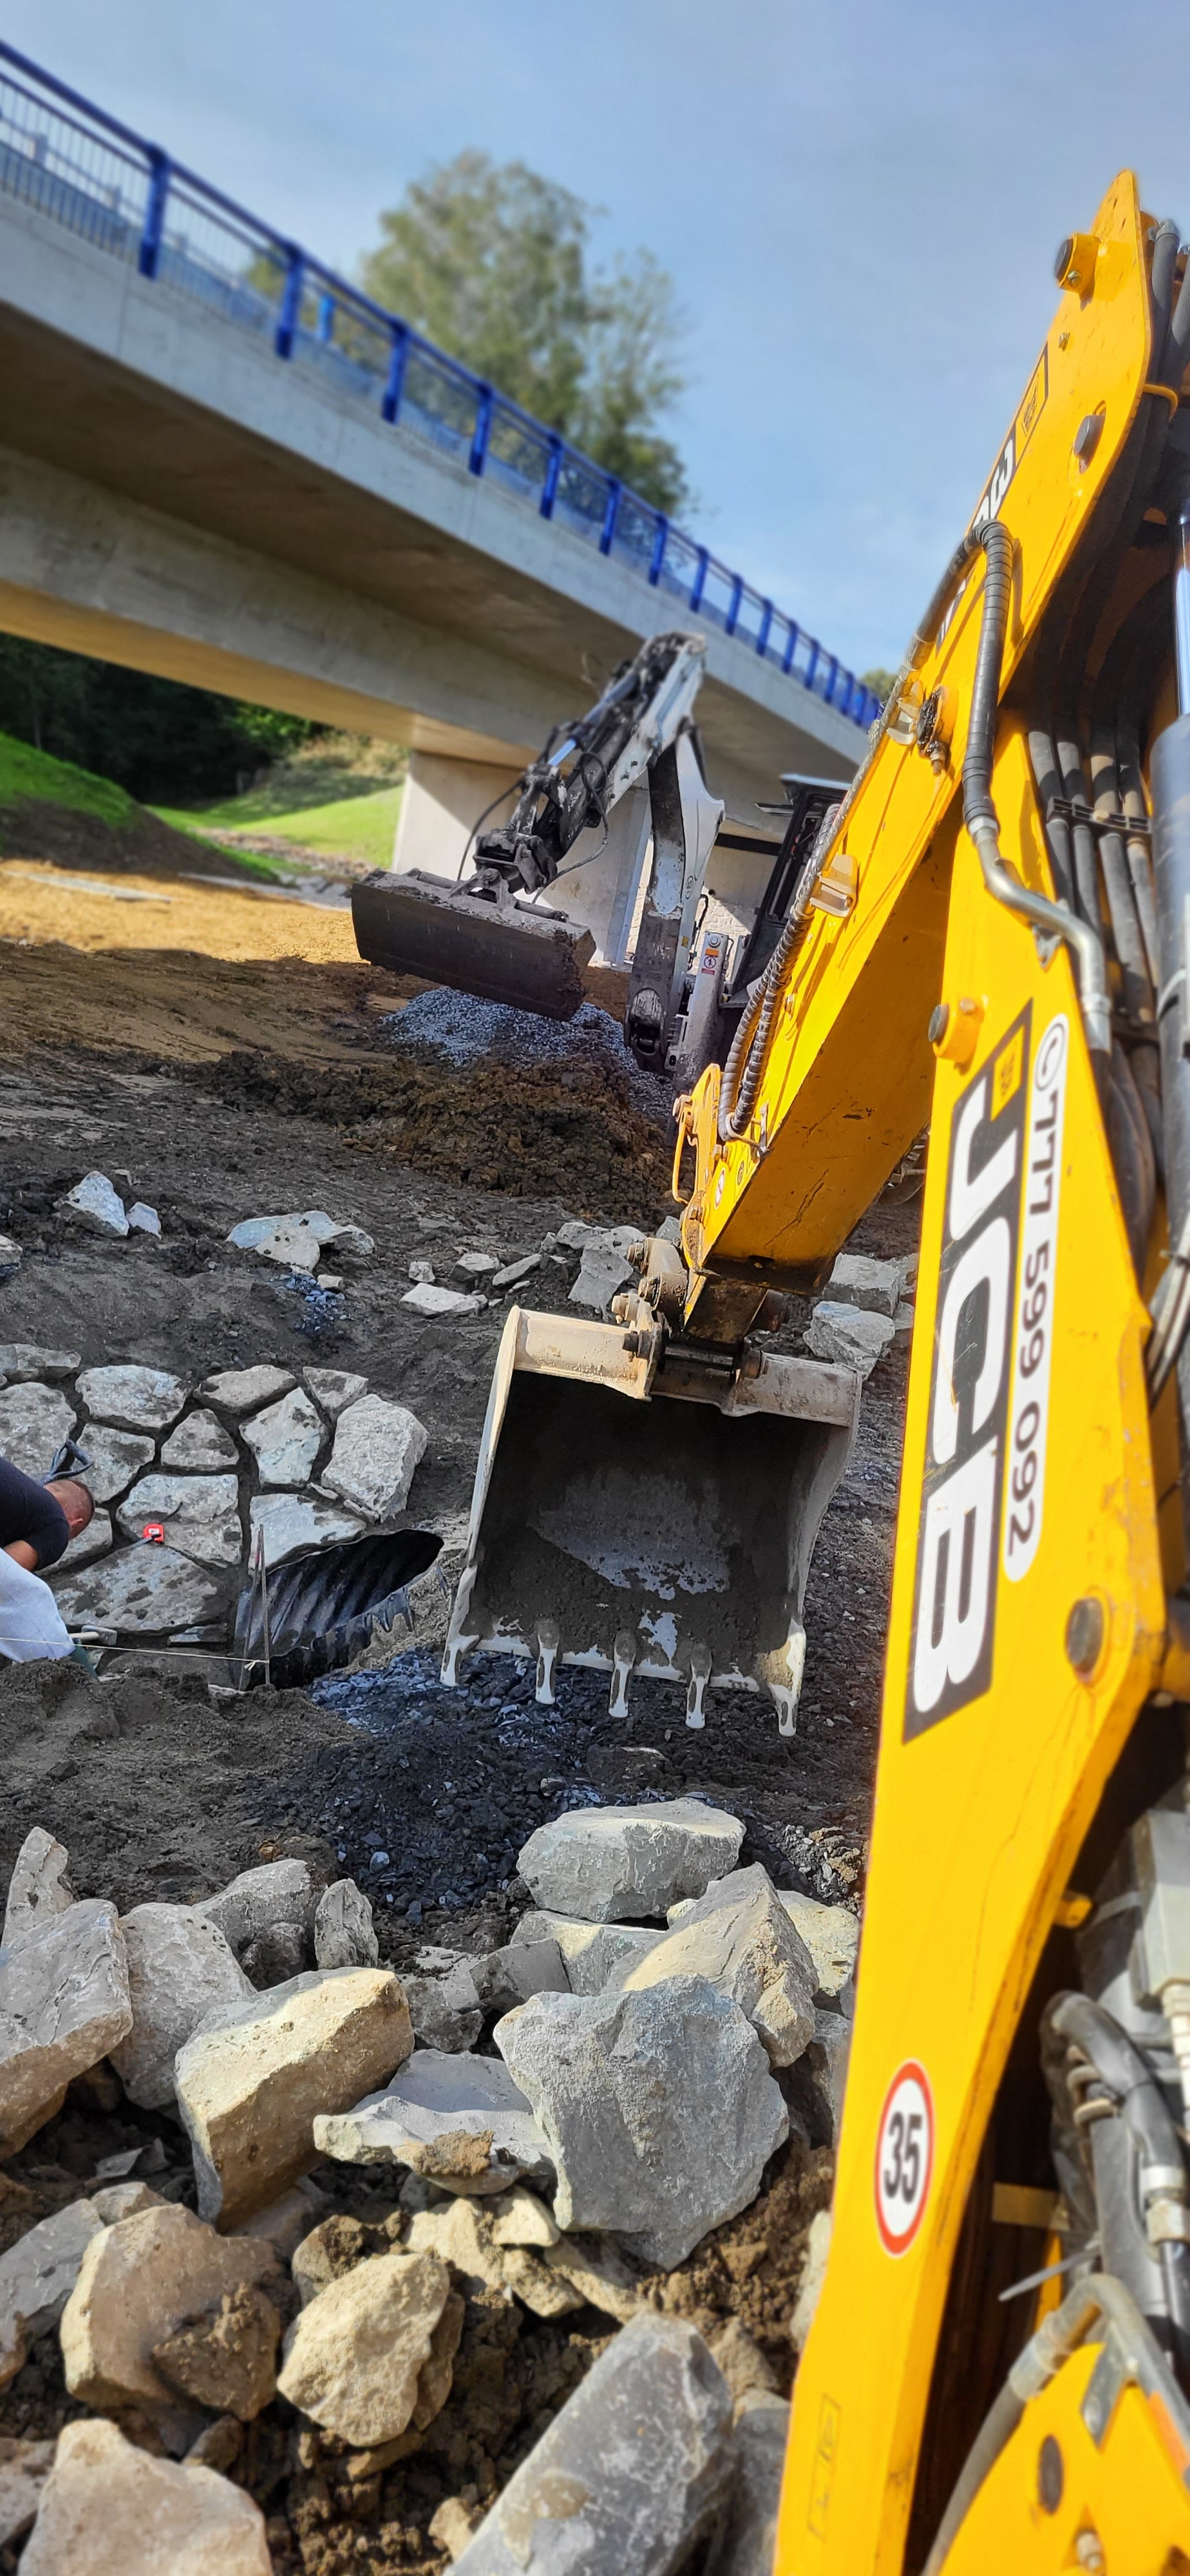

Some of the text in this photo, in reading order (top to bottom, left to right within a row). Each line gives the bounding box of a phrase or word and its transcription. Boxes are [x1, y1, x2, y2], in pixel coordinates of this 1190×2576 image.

[914, 1075, 1017, 1713] JCB
[1008, 1089, 1058, 1557] 777 599 092
[883, 2110, 922, 2204] 35
